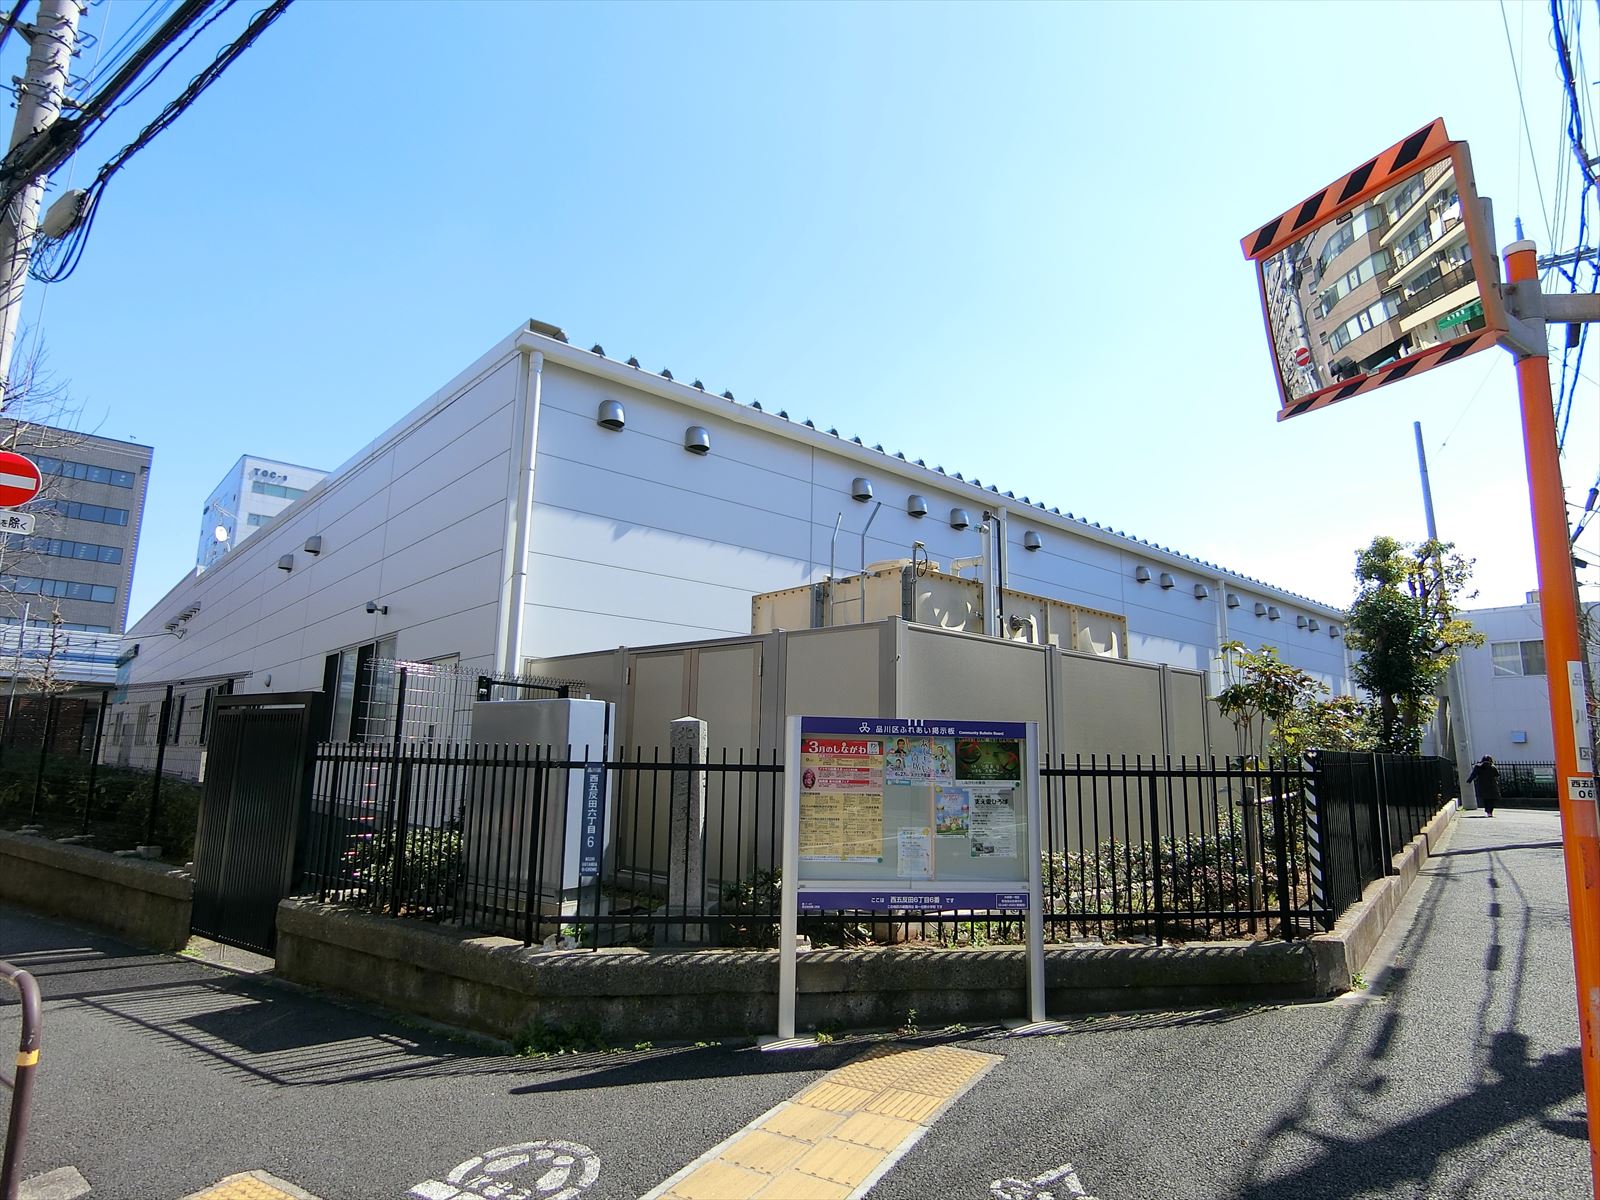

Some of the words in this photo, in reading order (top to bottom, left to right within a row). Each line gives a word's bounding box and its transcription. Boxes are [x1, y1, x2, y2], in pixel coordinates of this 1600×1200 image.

[0, 516, 28, 531] を除く
[875, 725, 955, 735] 品川区ふれあい掲示板
[808, 741, 866, 754] 3月のしながわ
[890, 896, 940, 904] 西五反田6丁目6番
